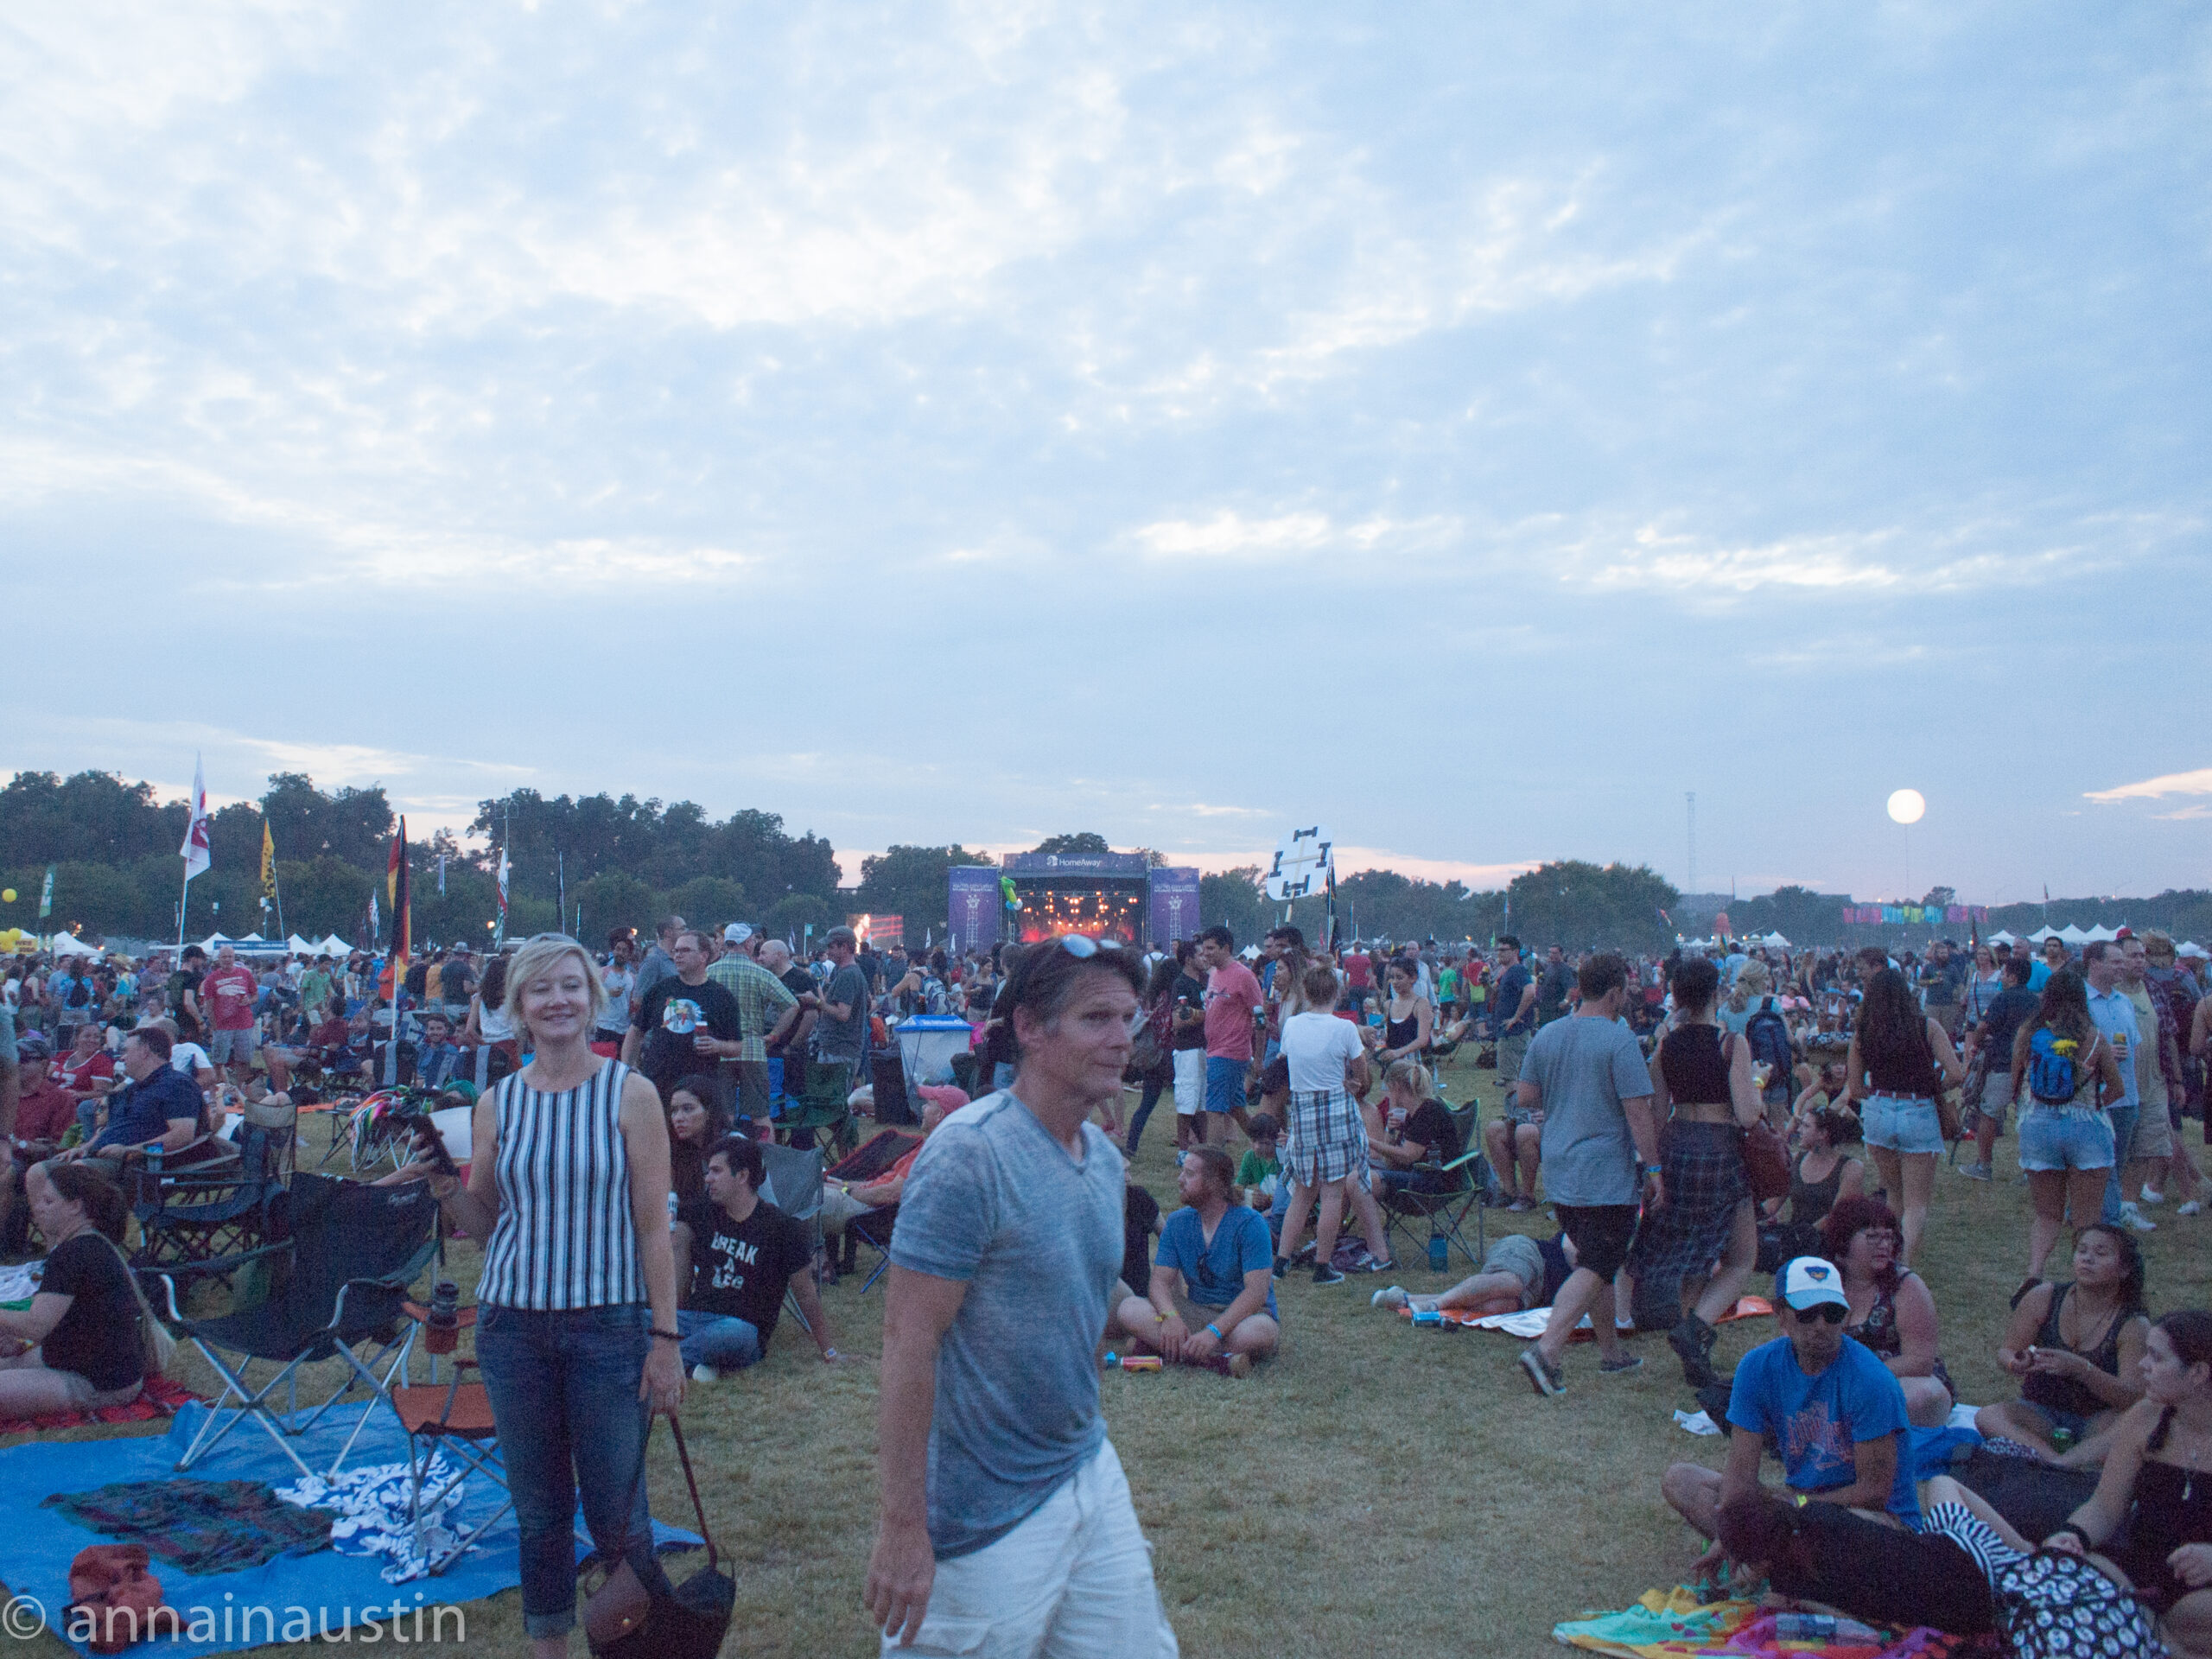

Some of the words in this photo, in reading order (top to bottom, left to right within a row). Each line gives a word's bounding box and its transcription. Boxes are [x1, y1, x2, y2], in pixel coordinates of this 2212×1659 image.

[1059, 858, 1101, 868] HomeAway
[41, 873, 53, 906] ATM
[724, 1257, 734, 1274] A
